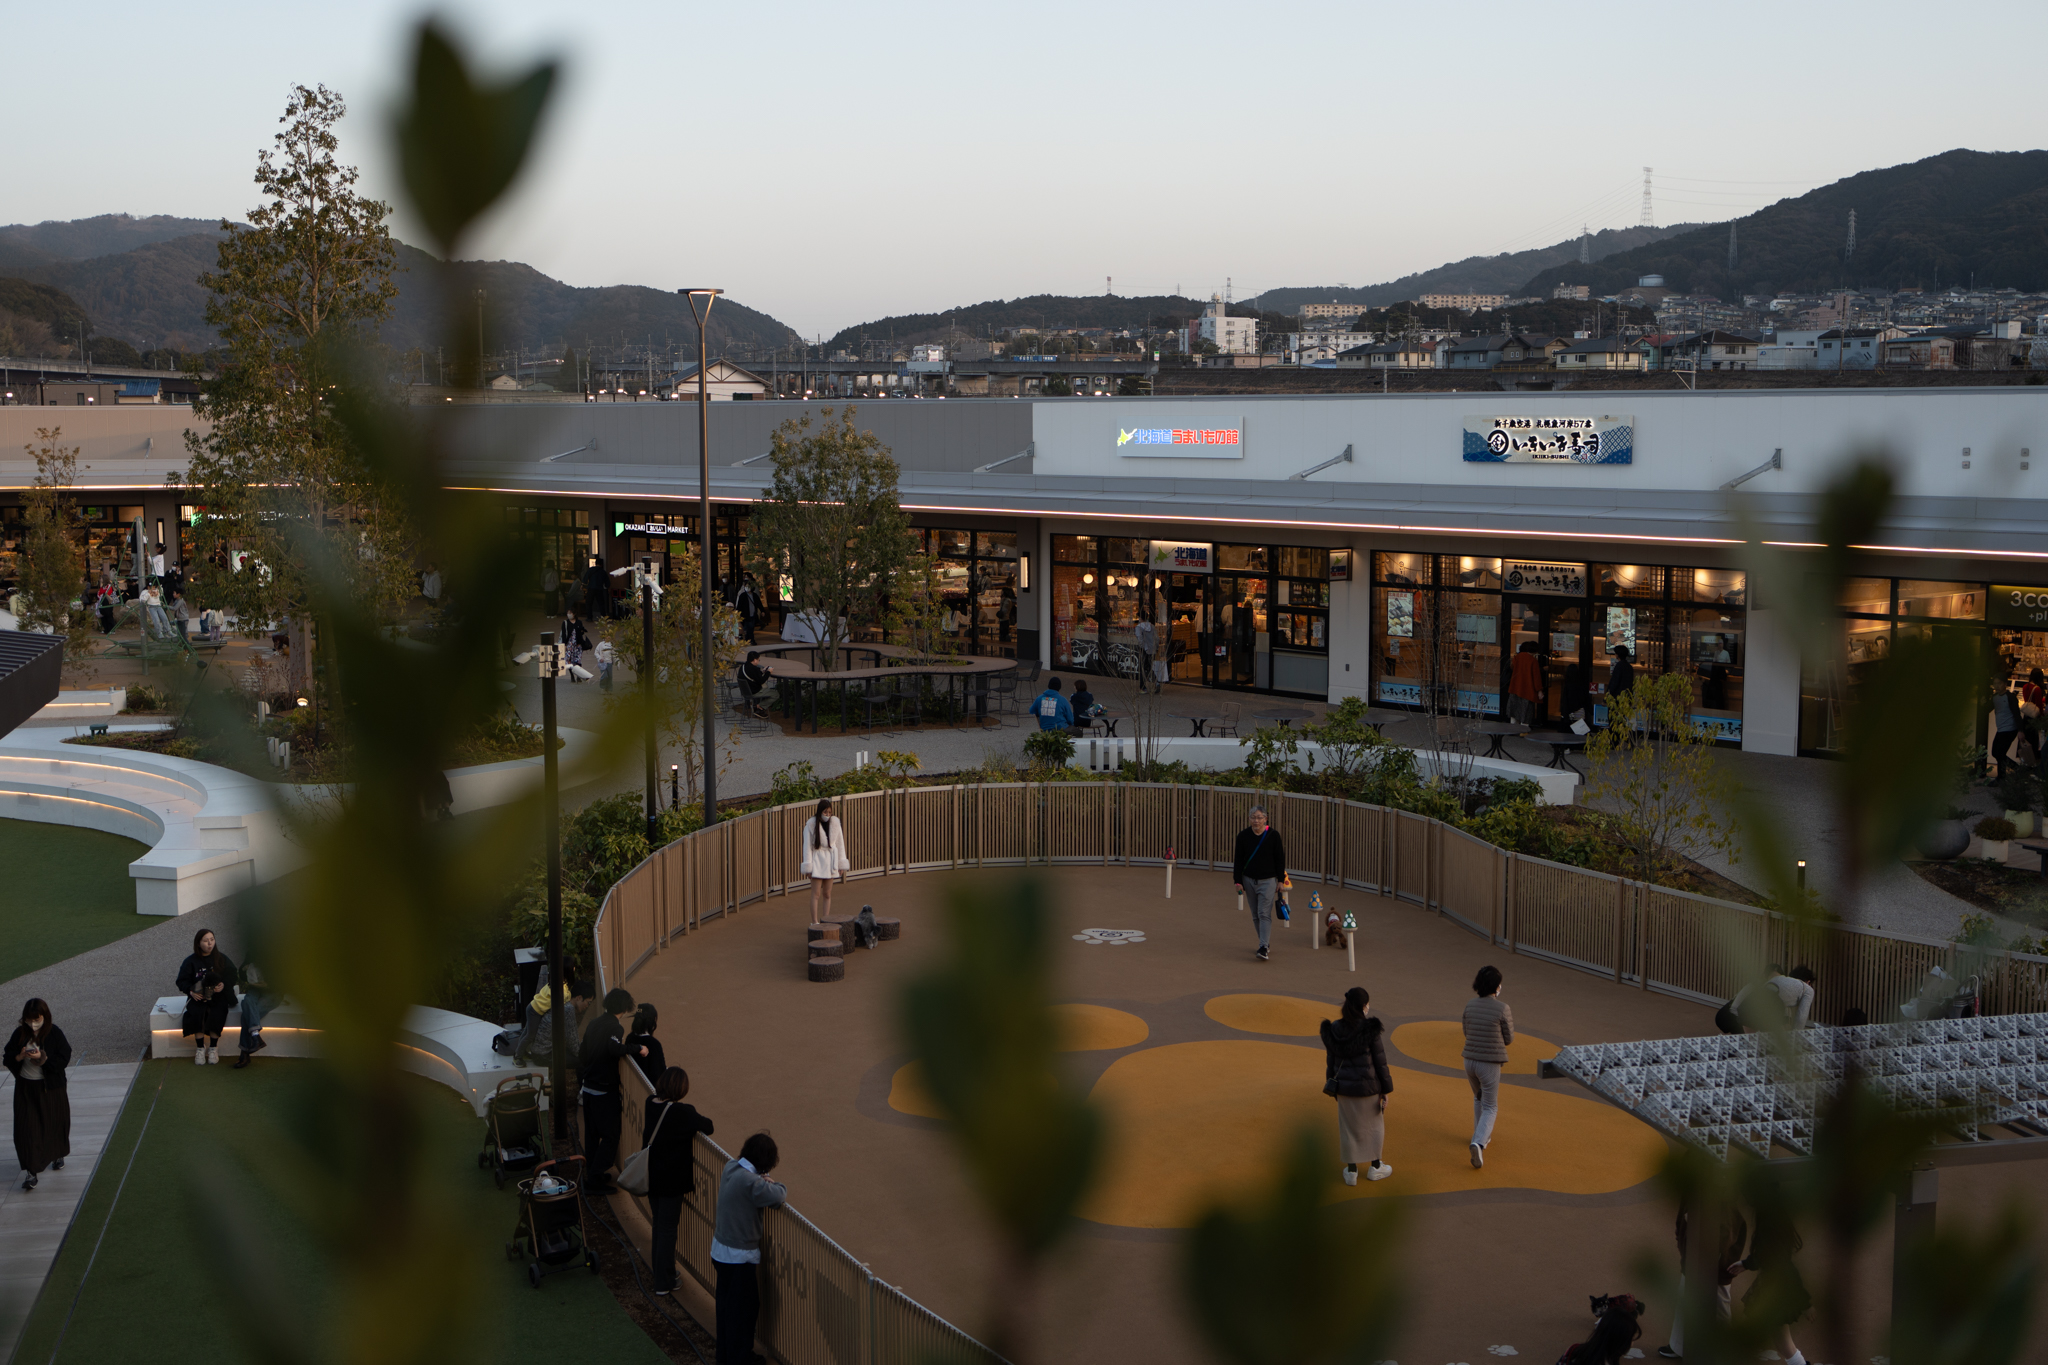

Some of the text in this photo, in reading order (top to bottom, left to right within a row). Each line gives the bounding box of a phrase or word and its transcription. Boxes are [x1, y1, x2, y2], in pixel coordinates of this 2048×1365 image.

[1134, 428, 1239, 445] 北海道うまいもの館
[624, 523, 646, 531] OKAZAKI
[667, 526, 689, 534] MARKET
[1174, 546, 1207, 560] 北海道
